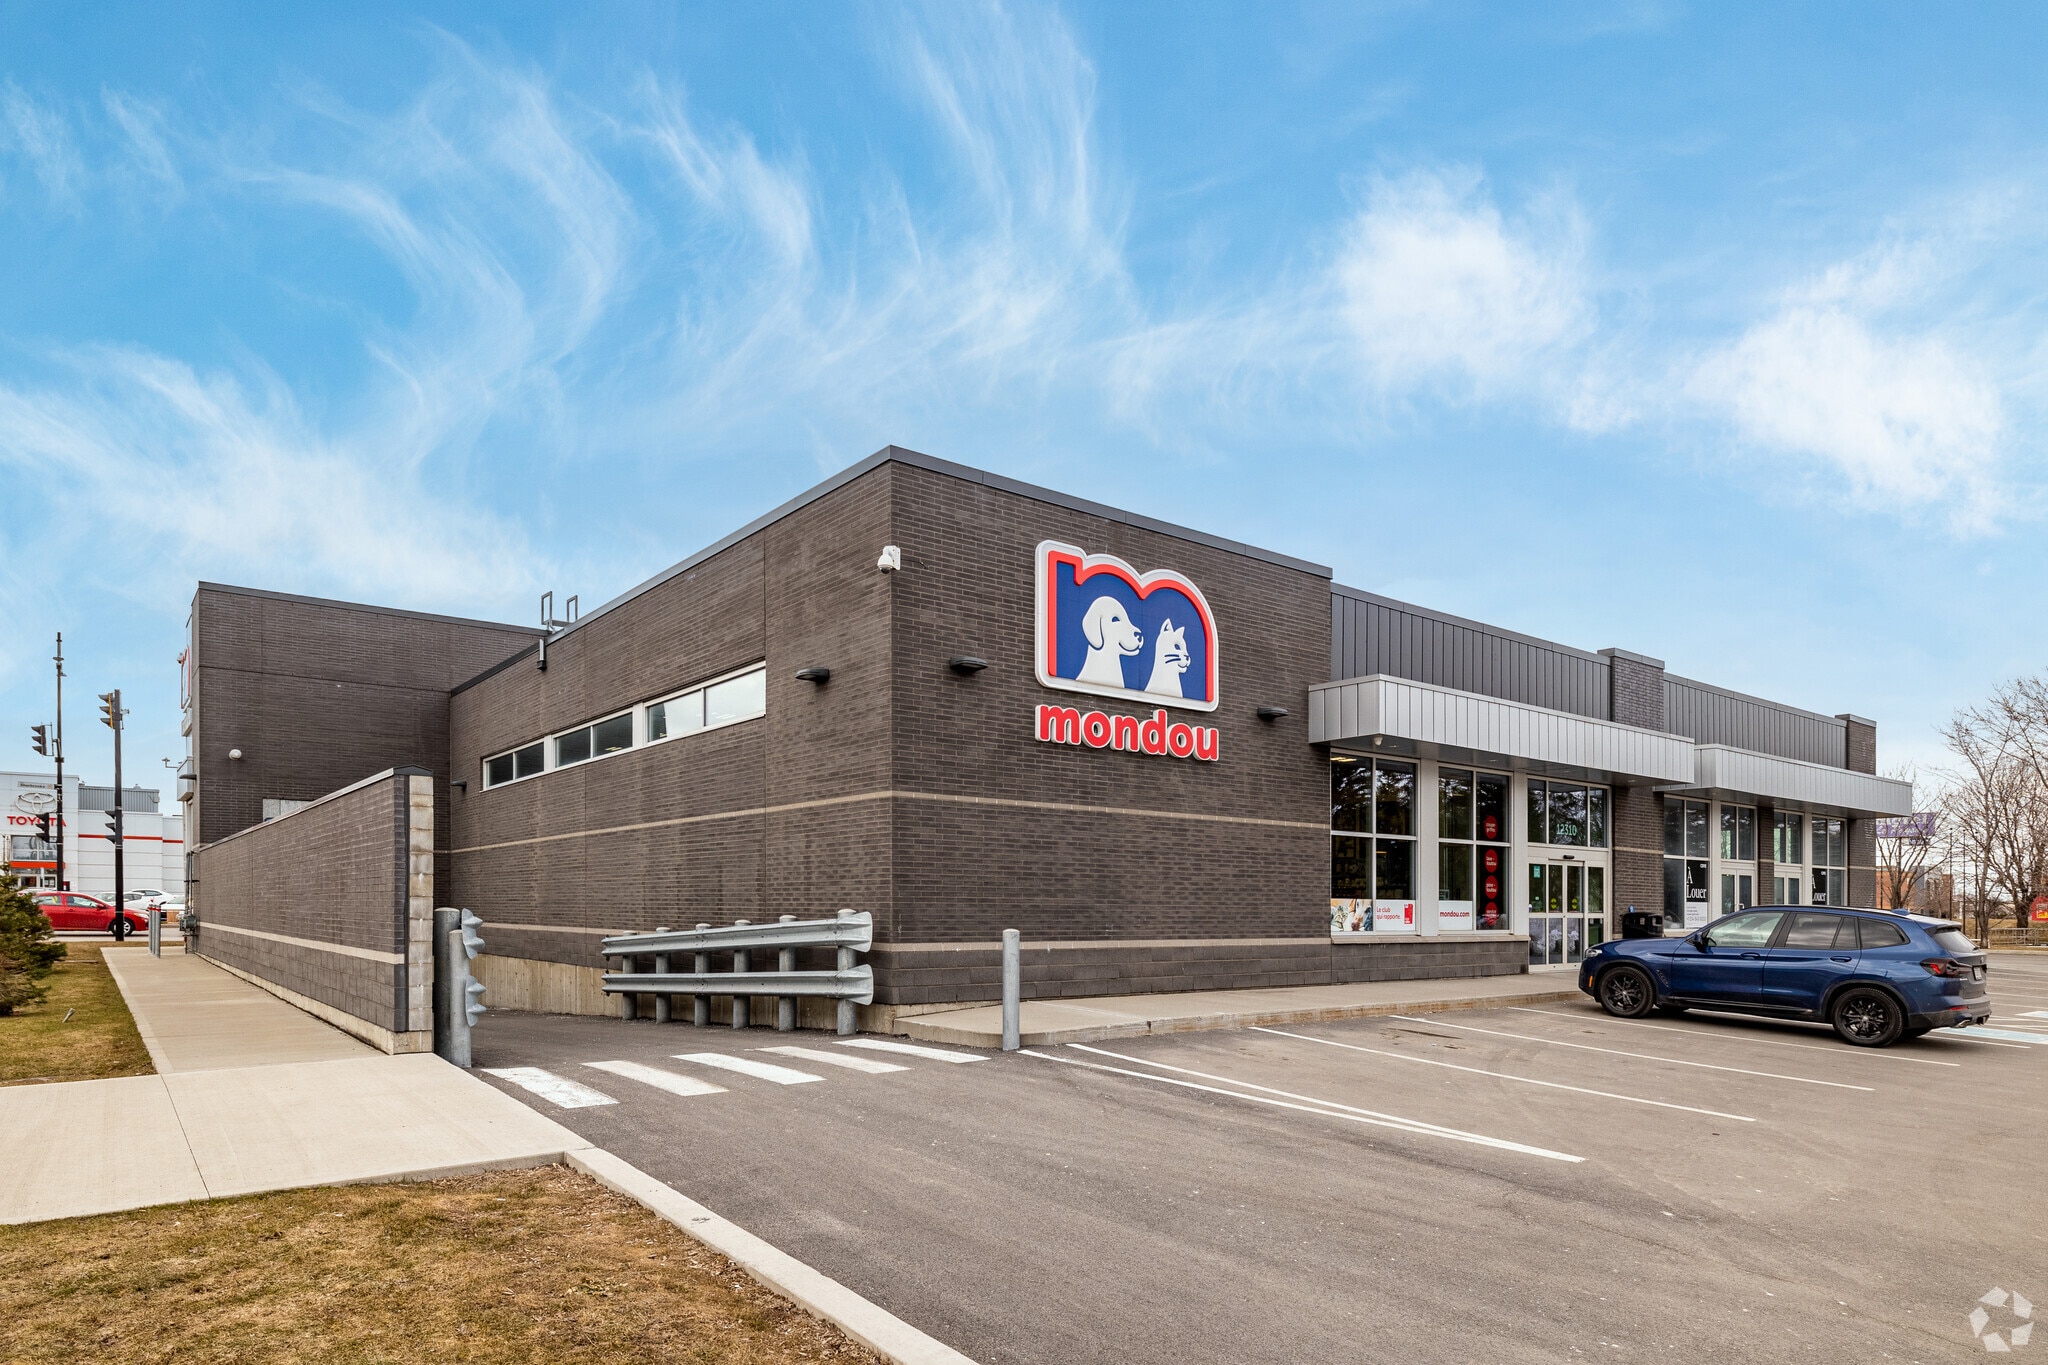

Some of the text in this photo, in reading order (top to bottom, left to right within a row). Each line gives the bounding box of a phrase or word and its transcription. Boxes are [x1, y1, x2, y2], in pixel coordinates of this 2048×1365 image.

[1035, 704, 1219, 761] mondou
[1556, 823, 1577, 836] 12310
[1686, 866, 1693, 884] À
[1686, 885, 1707, 899] Louer
[1812, 892, 1826, 902] ouer
